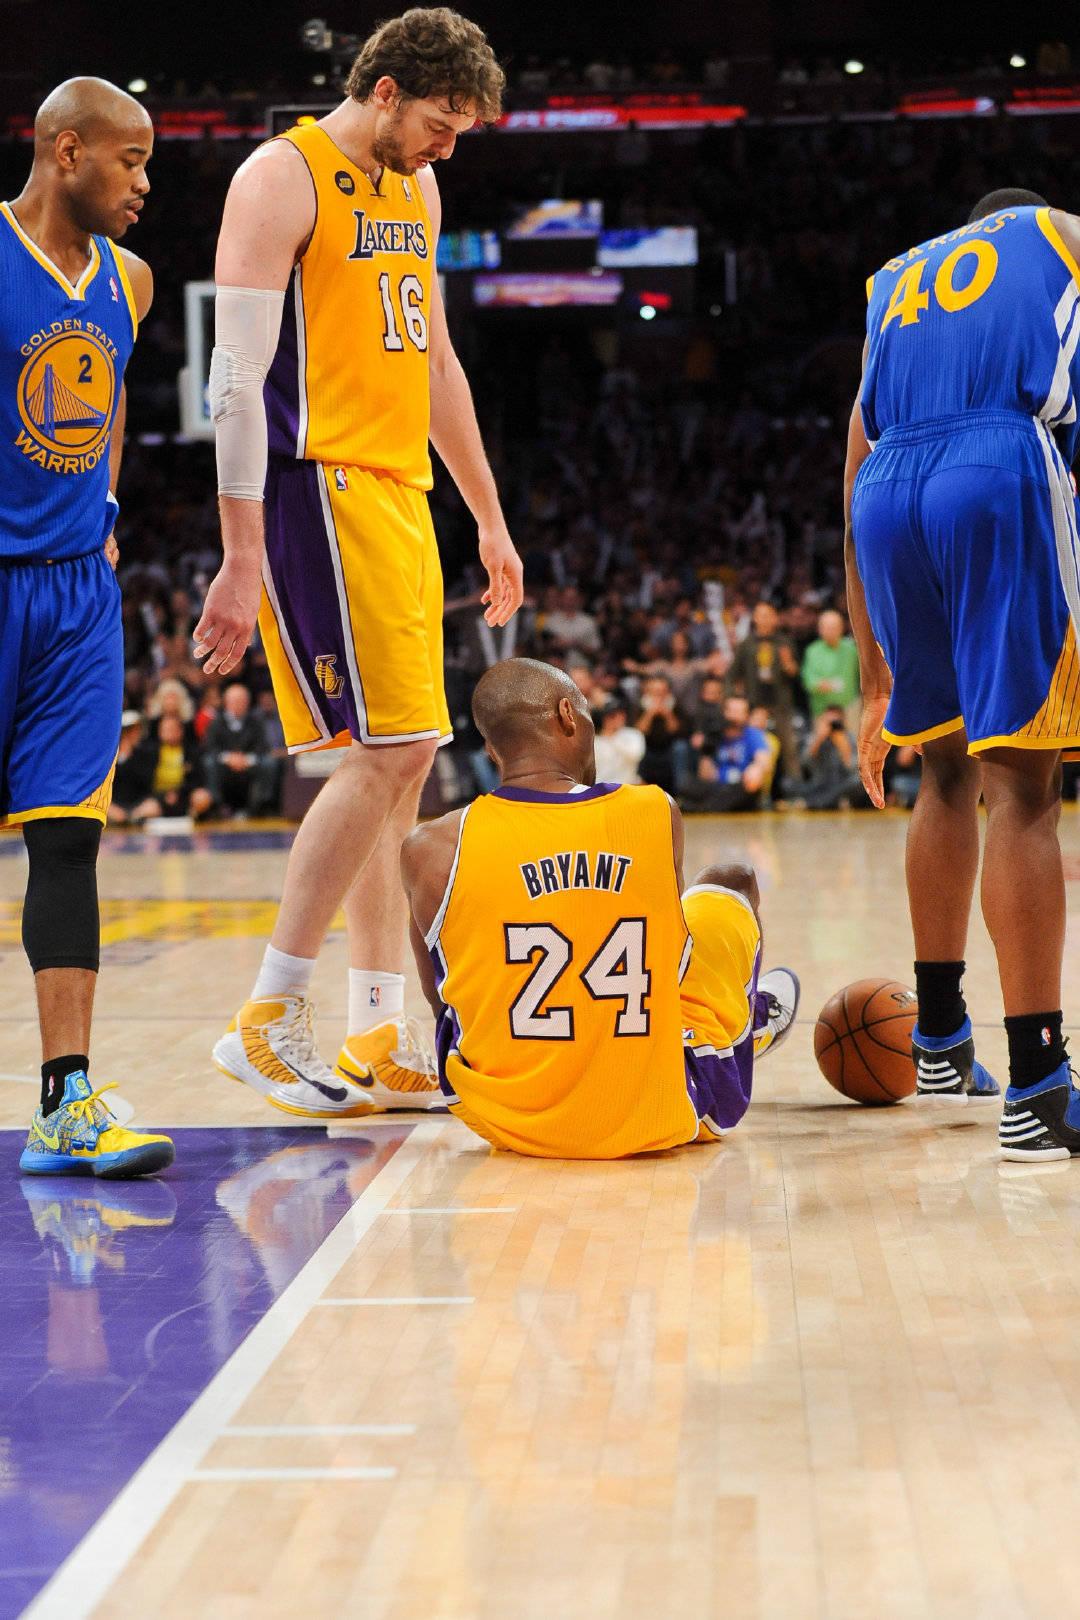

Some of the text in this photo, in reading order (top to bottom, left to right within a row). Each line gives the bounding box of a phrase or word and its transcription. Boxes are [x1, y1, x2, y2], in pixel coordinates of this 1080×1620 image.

[347, 210, 429, 260] LAKERS
[880, 239, 998, 334] 40
[379, 272, 427, 352] 16
[20, 319, 119, 361] GOLDEN STATE
[77, 353, 93, 384] 2
[519, 851, 633, 900] BRYANT
[503, 916, 652, 1041] 24
